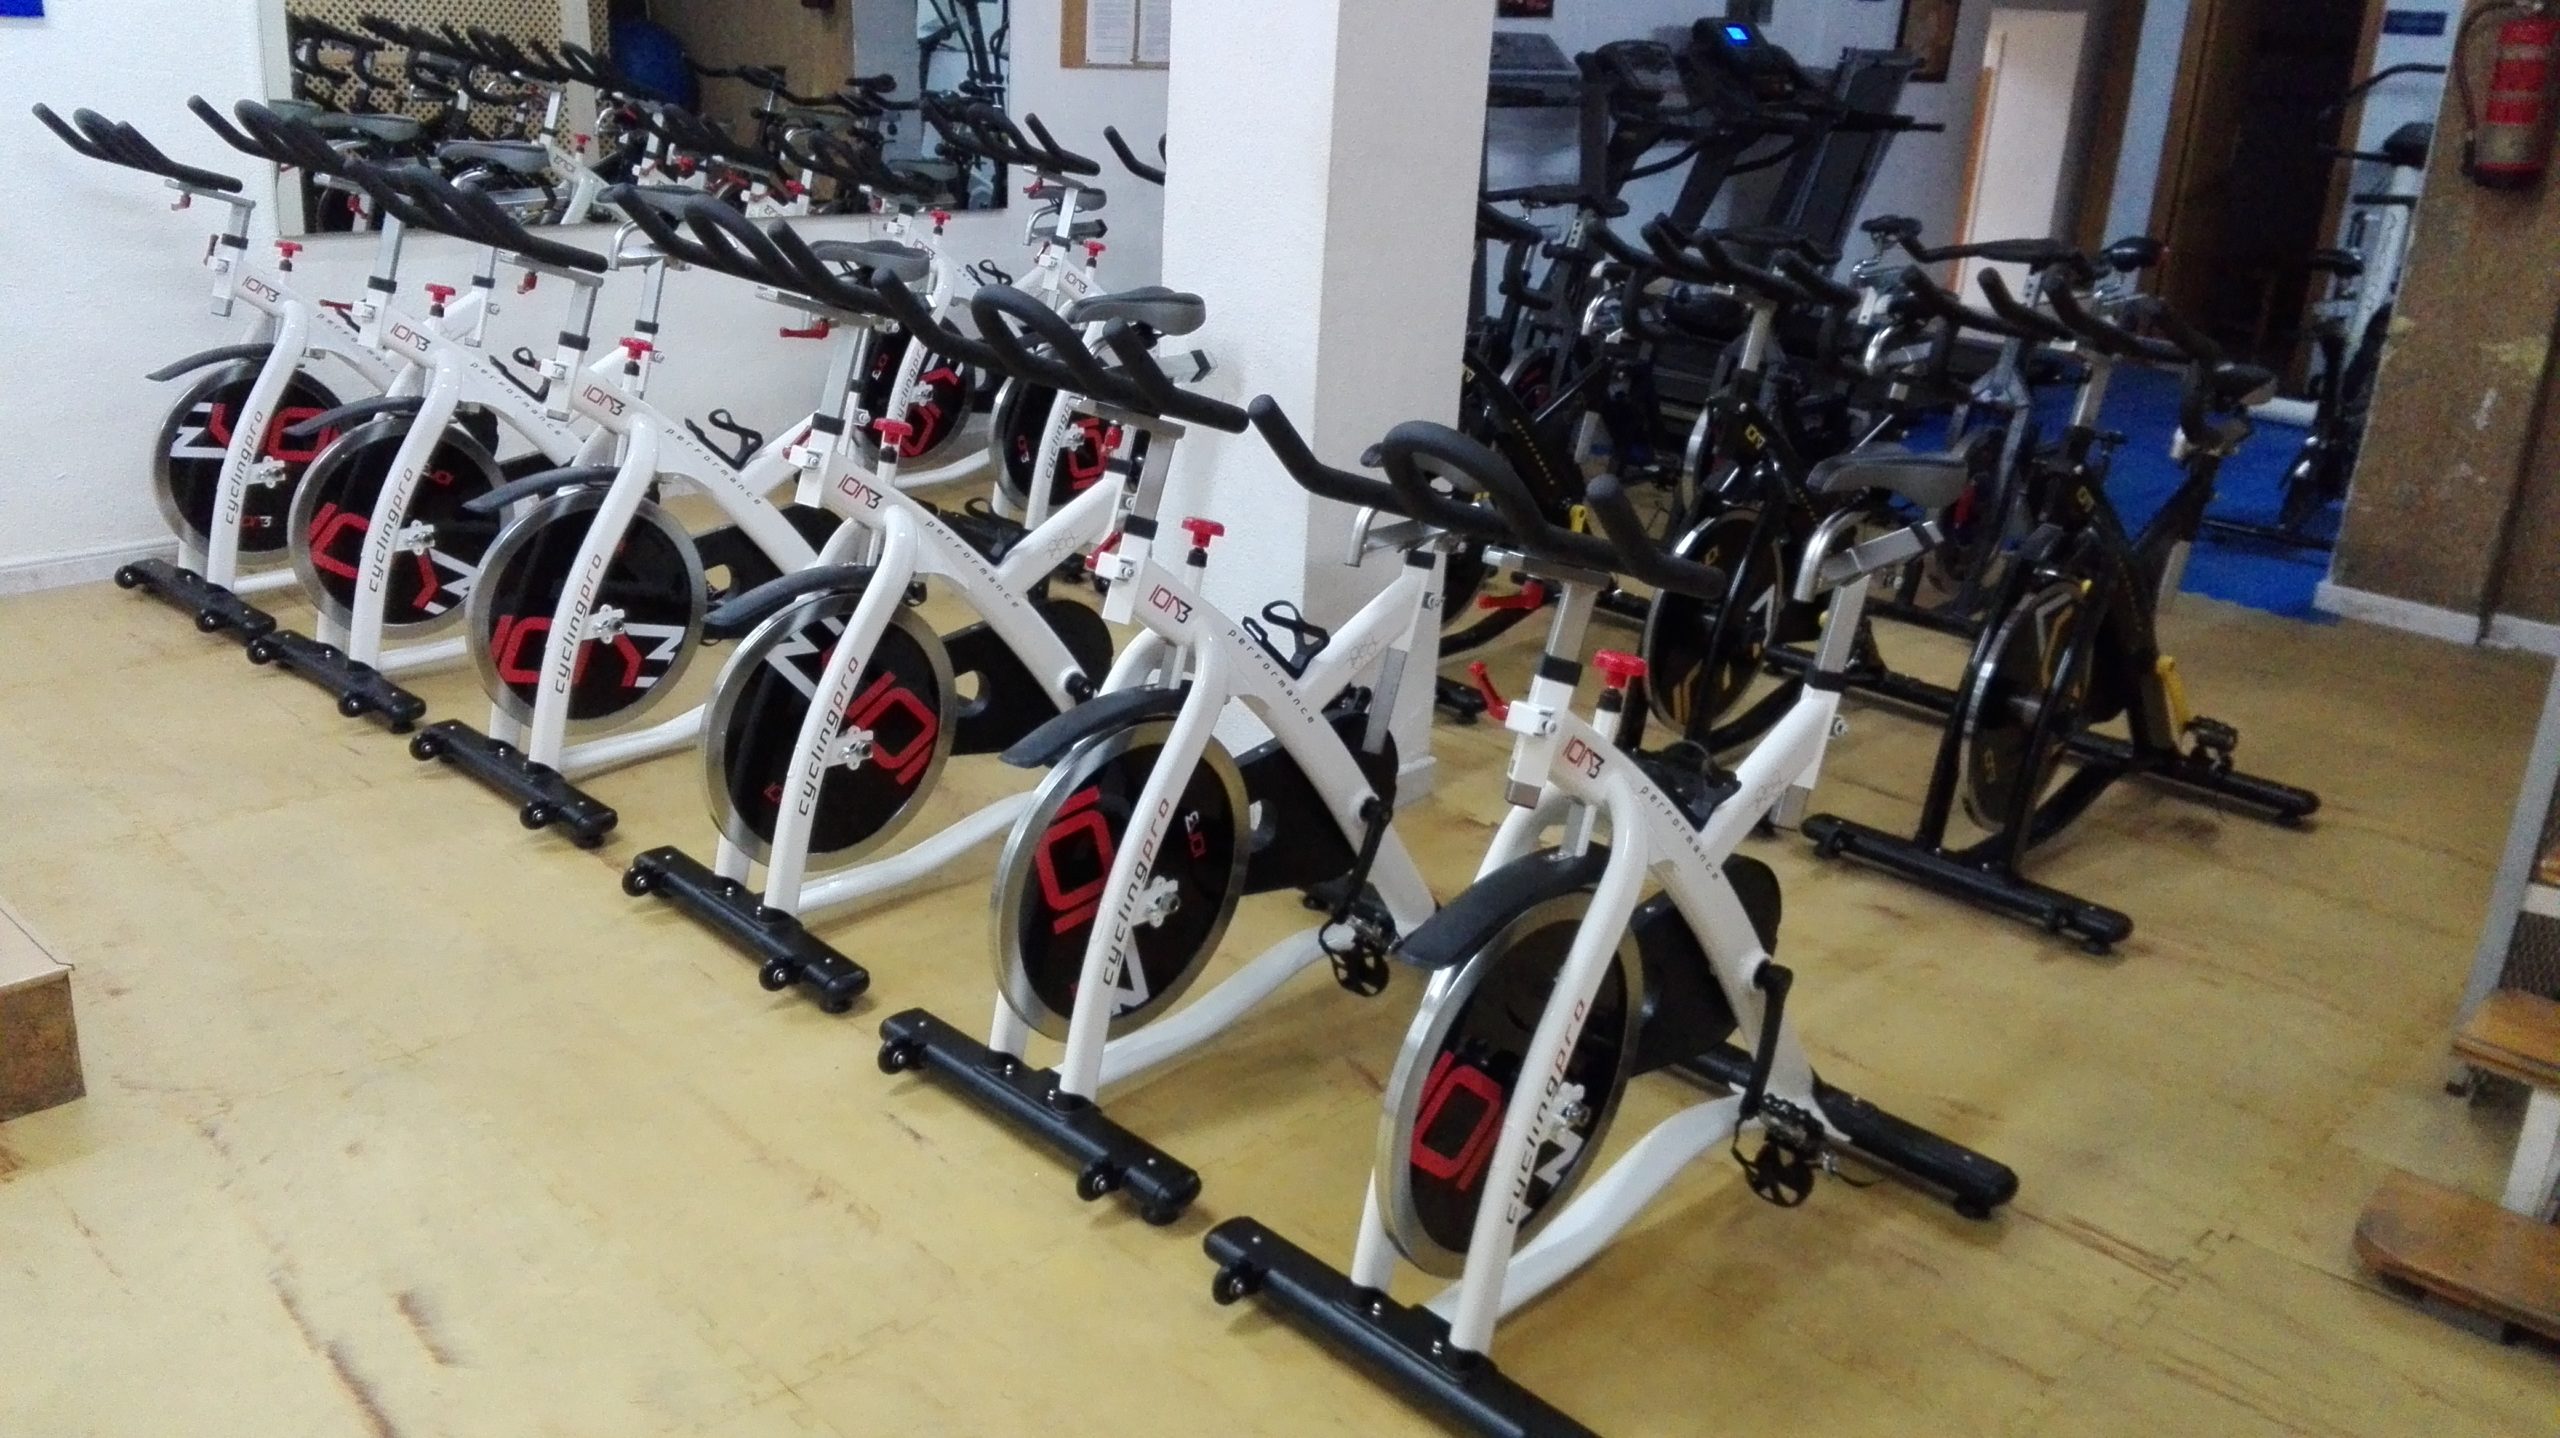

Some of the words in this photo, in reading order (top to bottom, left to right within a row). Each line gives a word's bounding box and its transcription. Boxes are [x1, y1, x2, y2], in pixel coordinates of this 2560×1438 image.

[225, 410, 264, 525] cyclingpro
[369, 467, 414, 593] cyclingpro
[555, 552, 602, 695] cyclingpro
[798, 656, 860, 817] cyclingpro
[1103, 798, 1170, 987] cyclingpro
[1506, 999, 1586, 1226] cyclingpro
